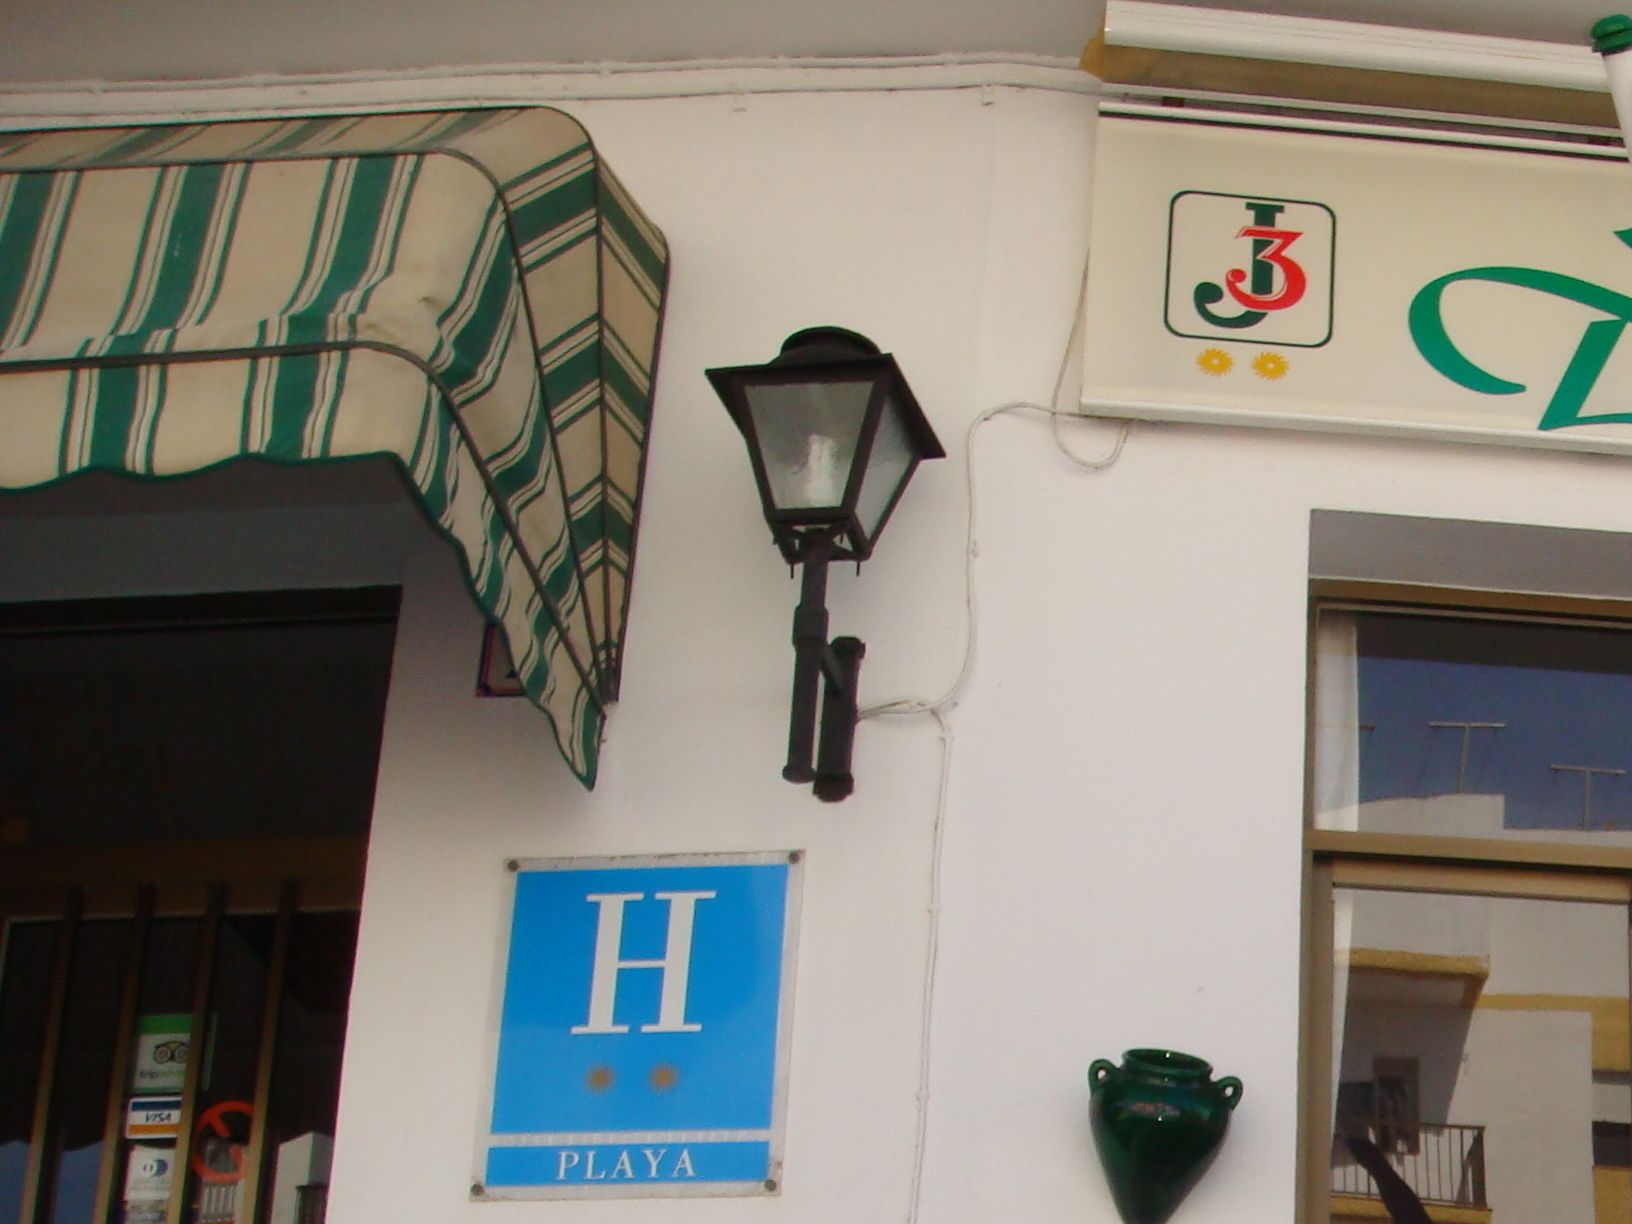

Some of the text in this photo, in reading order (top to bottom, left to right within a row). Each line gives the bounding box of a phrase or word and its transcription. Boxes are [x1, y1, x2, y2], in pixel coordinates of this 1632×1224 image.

[570, 890, 717, 1036] H
[144, 1111, 172, 1123] VISA
[555, 1148, 698, 1182] PLAYA
